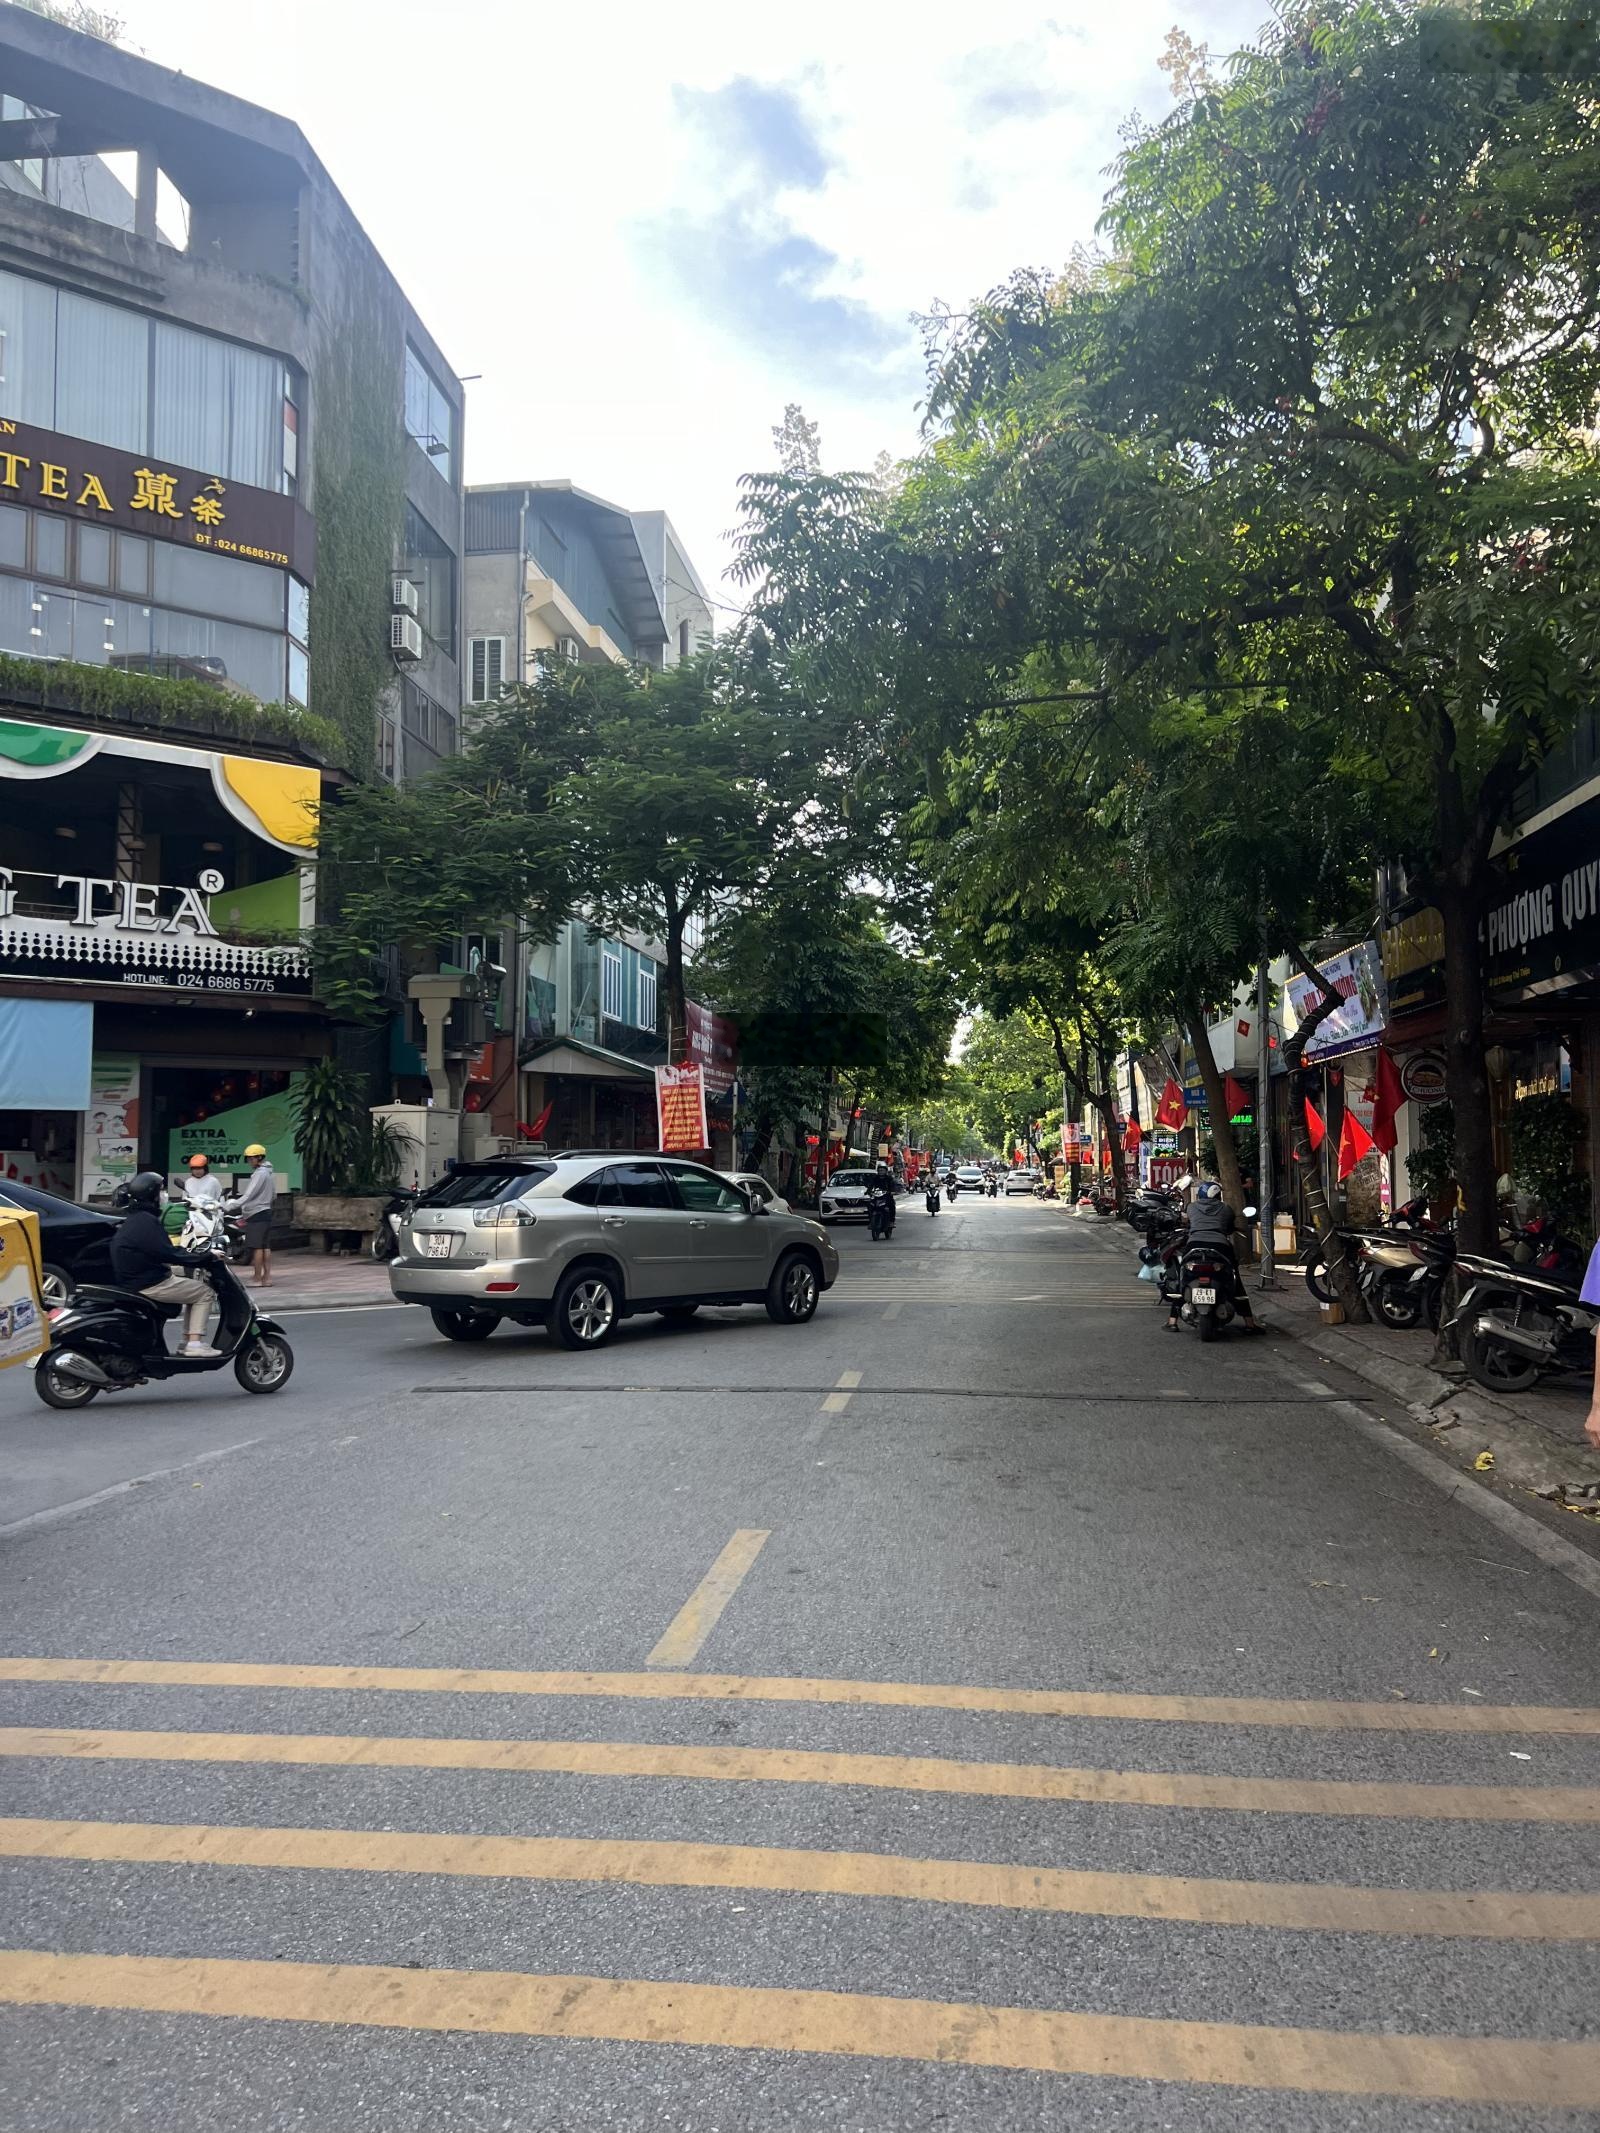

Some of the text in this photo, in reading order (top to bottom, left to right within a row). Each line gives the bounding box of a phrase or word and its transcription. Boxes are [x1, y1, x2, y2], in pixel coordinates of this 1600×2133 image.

[0, 451, 114, 512] TEA
[240, 544, 289, 564] 66865775
[57, 874, 219, 936] TEA
[1488, 883, 1554, 957] PHƯỢNG
[1561, 858, 1600, 931] QUY
[123, 973, 275, 992] HOTLINE: 024 6686 5775
[181, 1128, 226, 1138] EXTRA
